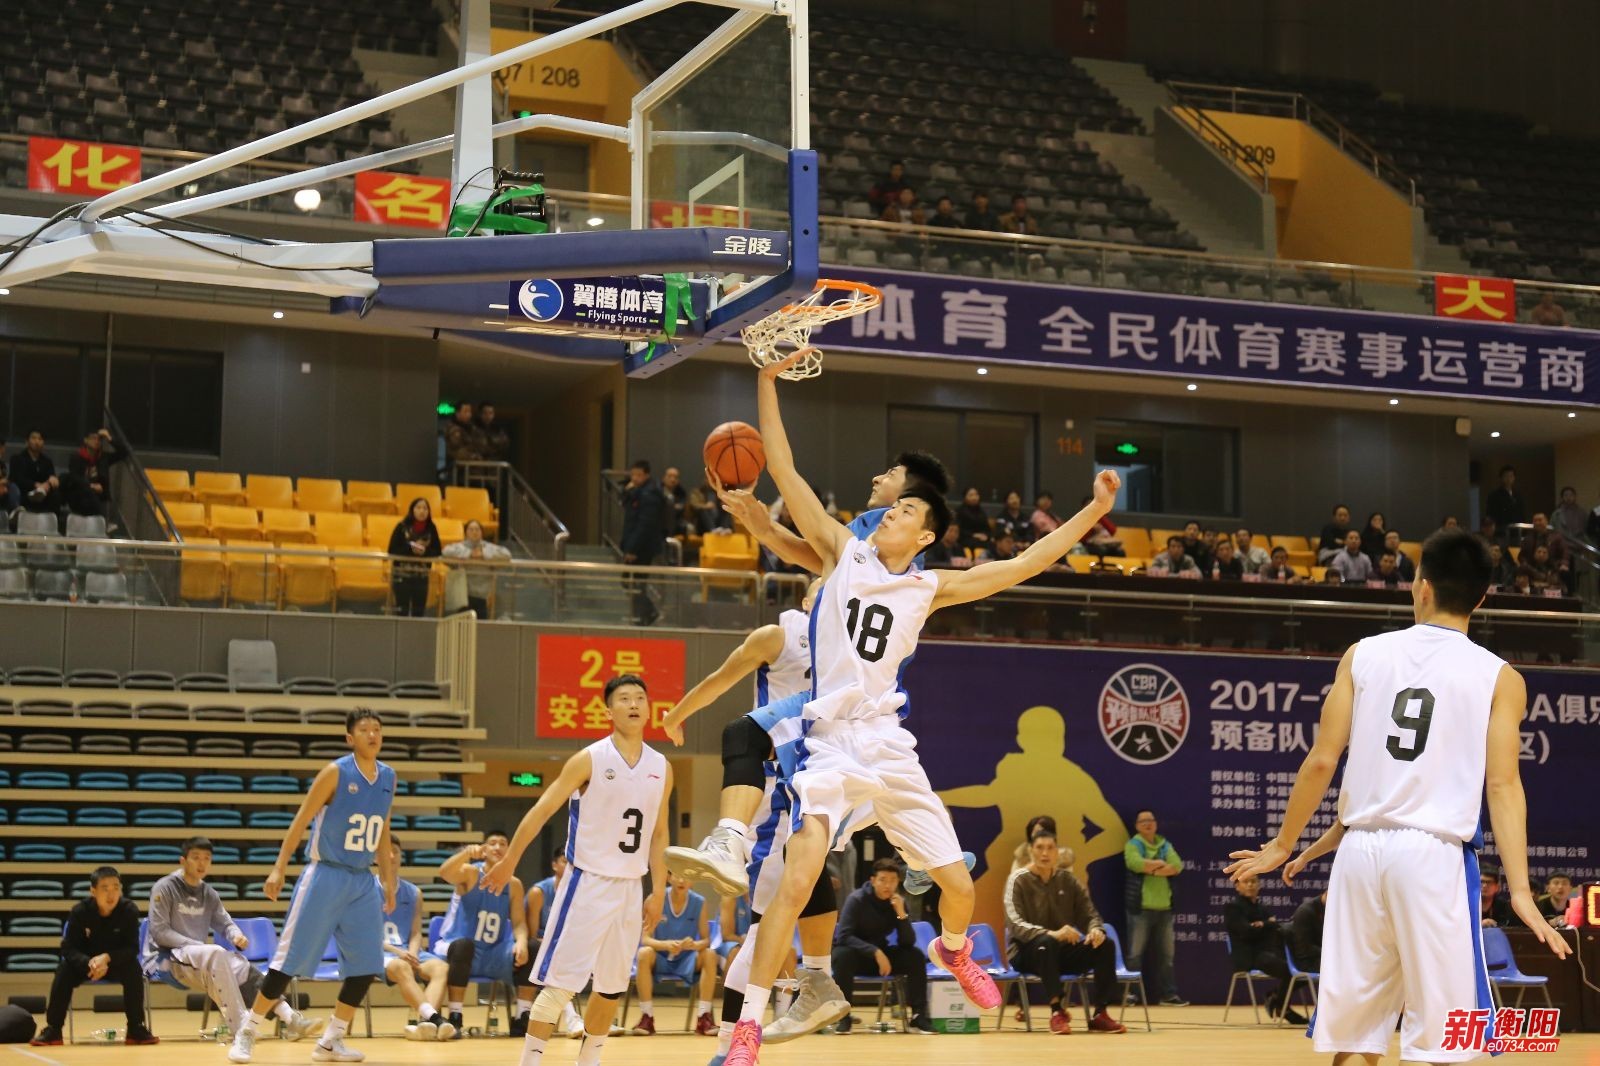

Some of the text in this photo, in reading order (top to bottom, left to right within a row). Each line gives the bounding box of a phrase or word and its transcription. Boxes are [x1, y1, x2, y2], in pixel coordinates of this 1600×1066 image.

[541, 66, 580, 88] 208
[42, 142, 132, 190] 化
[367, 176, 444, 223] 名
[724, 235, 773, 255] 金陵
[573, 283, 664, 314] 翼腾体育
[588, 309, 647, 324] Flying Sports
[1442, 280, 1507, 318] 大
[804, 283, 1587, 394] 体育 全民体育赛事运营商
[846, 597, 894, 663] 18
[579, 649, 645, 688] 2号
[1131, 674, 1158, 690] CBA
[548, 693, 676, 730] 安全口
[1386, 687, 1436, 762] 9
[1523, 693, 1600, 725] A俱
[1210, 720, 1321, 752] 预备队
[344, 813, 384, 852] 20
[618, 808, 643, 853] 3
[474, 910, 500, 943] 19
